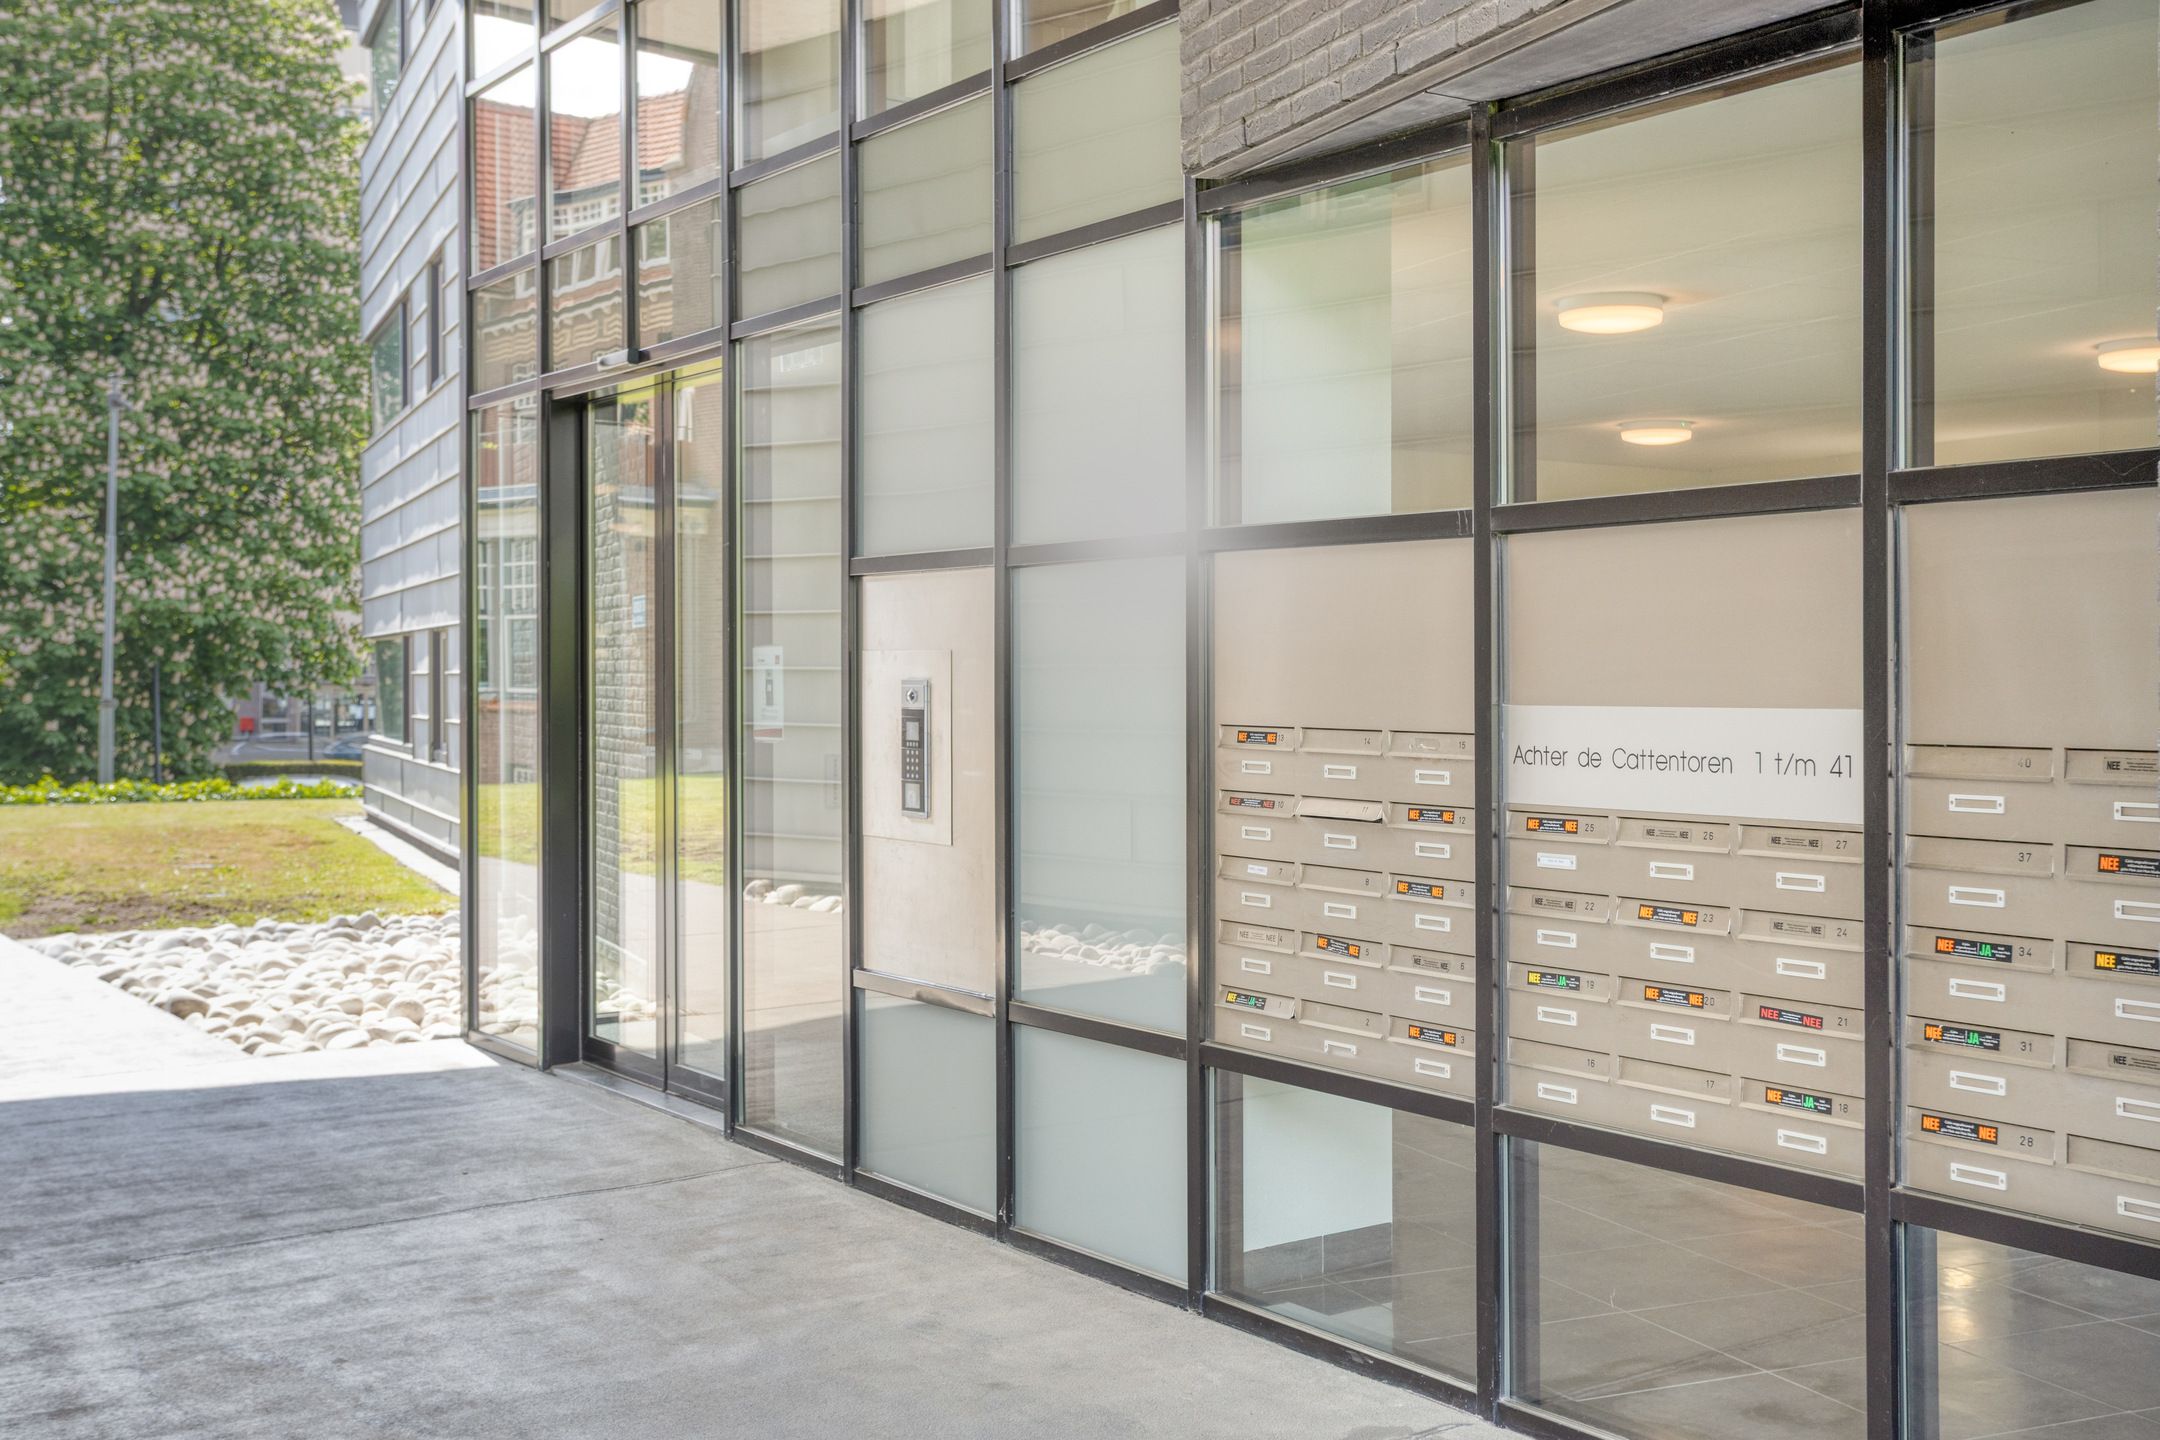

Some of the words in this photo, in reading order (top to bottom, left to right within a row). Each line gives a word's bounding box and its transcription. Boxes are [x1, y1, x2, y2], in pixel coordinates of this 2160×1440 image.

[1238, 732, 1247, 742] NEE
[1267, 733, 1277, 744] NEE
[1278, 734, 1284, 742] 13
[1513, 745, 1568, 767] Achter
[1578, 747, 1602, 767] de
[1612, 747, 1733, 774] Cattentoren
[1754, 752, 1762, 773] 1
[1774, 752, 1816, 777] t/m
[1829, 755, 1853, 778] 41
[2107, 761, 2120, 771] NEE
[1231, 797, 1241, 805] NEE
[1263, 800, 1274, 808] NEE
[1409, 809, 1419, 820] NEE
[1443, 811, 1454, 822] NEE
[1527, 819, 1539, 831] NEE
[1565, 821, 1577, 833] NEE
[1585, 824, 1595, 832] 25
[1646, 828, 1655, 837] NEE
[1679, 830, 1688, 839] NEE
[1703, 832, 1714, 841] 26
[1771, 836, 1781, 845] NEE
[1808, 838, 1819, 848] NEE
[1836, 840, 1847, 849] 27
[2018, 853, 2031, 862] 37
[2099, 856, 2120, 871] NEE
[1398, 881, 1408, 893] NEE
[1432, 886, 1443, 898] NEE
[1534, 897, 1543, 905] NEE
[1565, 900, 1573, 909] NEE
[1584, 902, 1595, 910] 22
[1639, 905, 1653, 919] NEE
[1683, 911, 1698, 925] NEE
[1703, 914, 1714, 922] 23
[1773, 921, 1784, 930] NEE
[1811, 925, 1821, 935] NEE
[1837, 927, 1847, 937] 24
[1240, 930, 1249, 938] NEE
[1266, 933, 1276, 942] NEE
[1318, 936, 1328, 948] NEE
[1349, 945, 1359, 957] NEE
[1365, 948, 1369, 956] 5
[1937, 938, 1955, 952] NEE
[1979, 944, 1992, 957] JA
[2019, 947, 2032, 957] 34
[2096, 953, 2116, 968] NEE
[1528, 971, 1540, 983] NEE
[1557, 975, 1566, 987] JA
[1227, 992, 1237, 1002] NEE
[1248, 996, 1255, 1006] JA
[1645, 987, 1658, 999] NEE
[1689, 993, 1703, 1005] NEE
[1705, 997, 1715, 1006] 20
[1366, 1018, 1369, 1026] 2
[1761, 1007, 1779, 1019] NEE
[1803, 1016, 1822, 1028] NEE
[1838, 1018, 1848, 1026] 21
[1409, 1025, 1420, 1037] NEE
[1444, 1033, 1455, 1045] NEE
[1461, 1036, 1465, 1044] 3
[1926, 1025, 1942, 1039] NEE
[1968, 1032, 1980, 1044] JA
[2020, 1042, 2032, 1052] 31
[1587, 1059, 1595, 1068] 16
[2113, 1056, 2127, 1065] NEE
[1706, 1080, 1715, 1088] 17
[1766, 1089, 1782, 1103] NEE
[1804, 1096, 1814, 1109] JA
[1839, 1104, 1848, 1113] 18
[1923, 1116, 1940, 1131] NEE
[1979, 1125, 1997, 1142] NEE
[2020, 1136, 2033, 1147] 28
